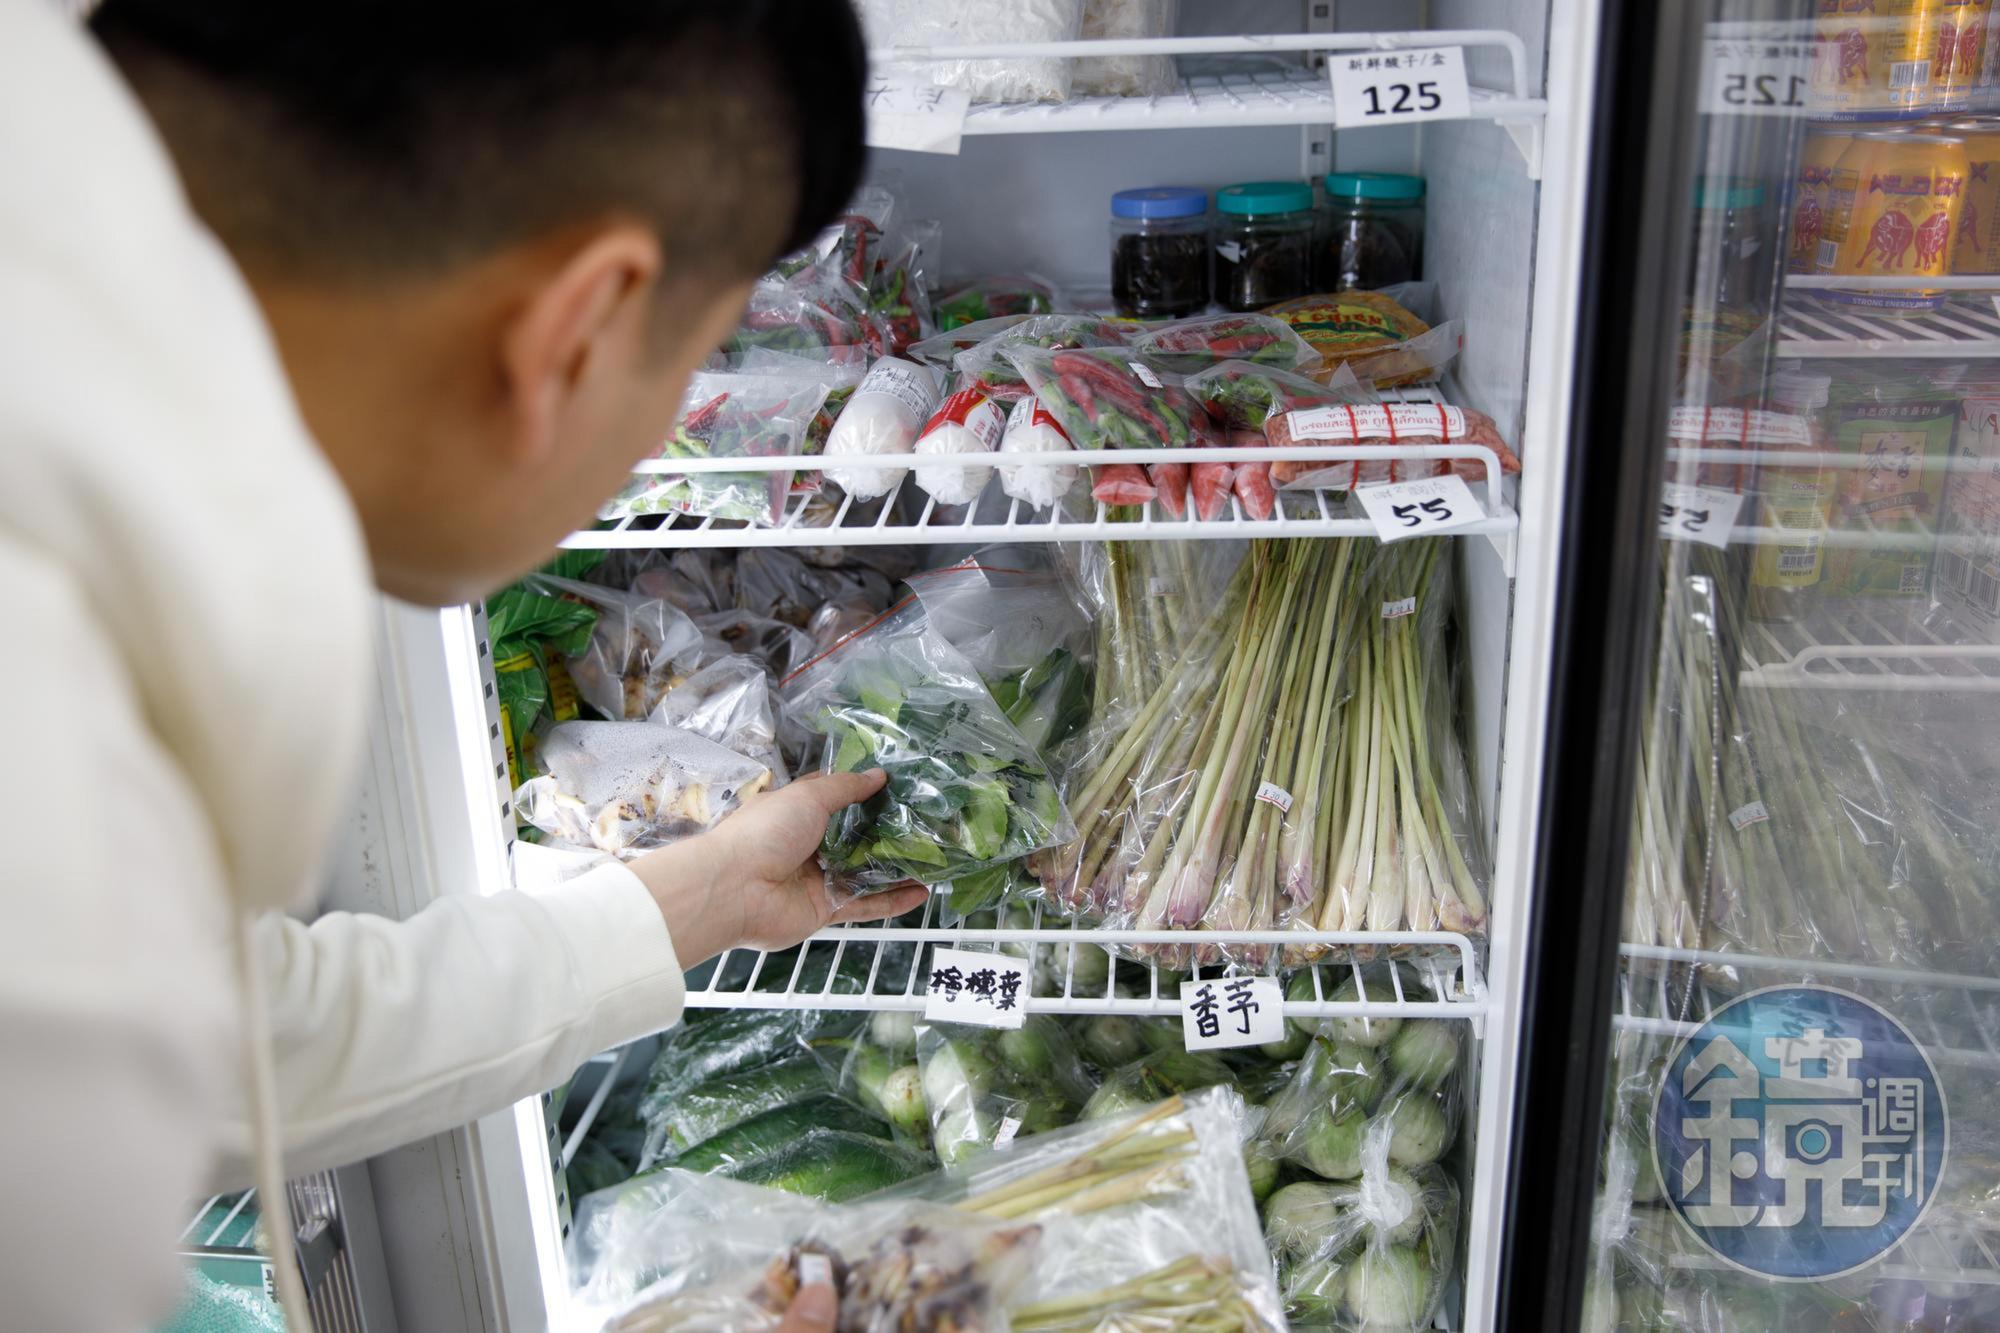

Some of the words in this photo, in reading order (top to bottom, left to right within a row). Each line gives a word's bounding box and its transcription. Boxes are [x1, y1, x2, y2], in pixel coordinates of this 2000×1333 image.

[1362, 82, 1442, 115] 125
[1391, 497, 1453, 527] 55
[1190, 976, 1260, 1038] 香茅
